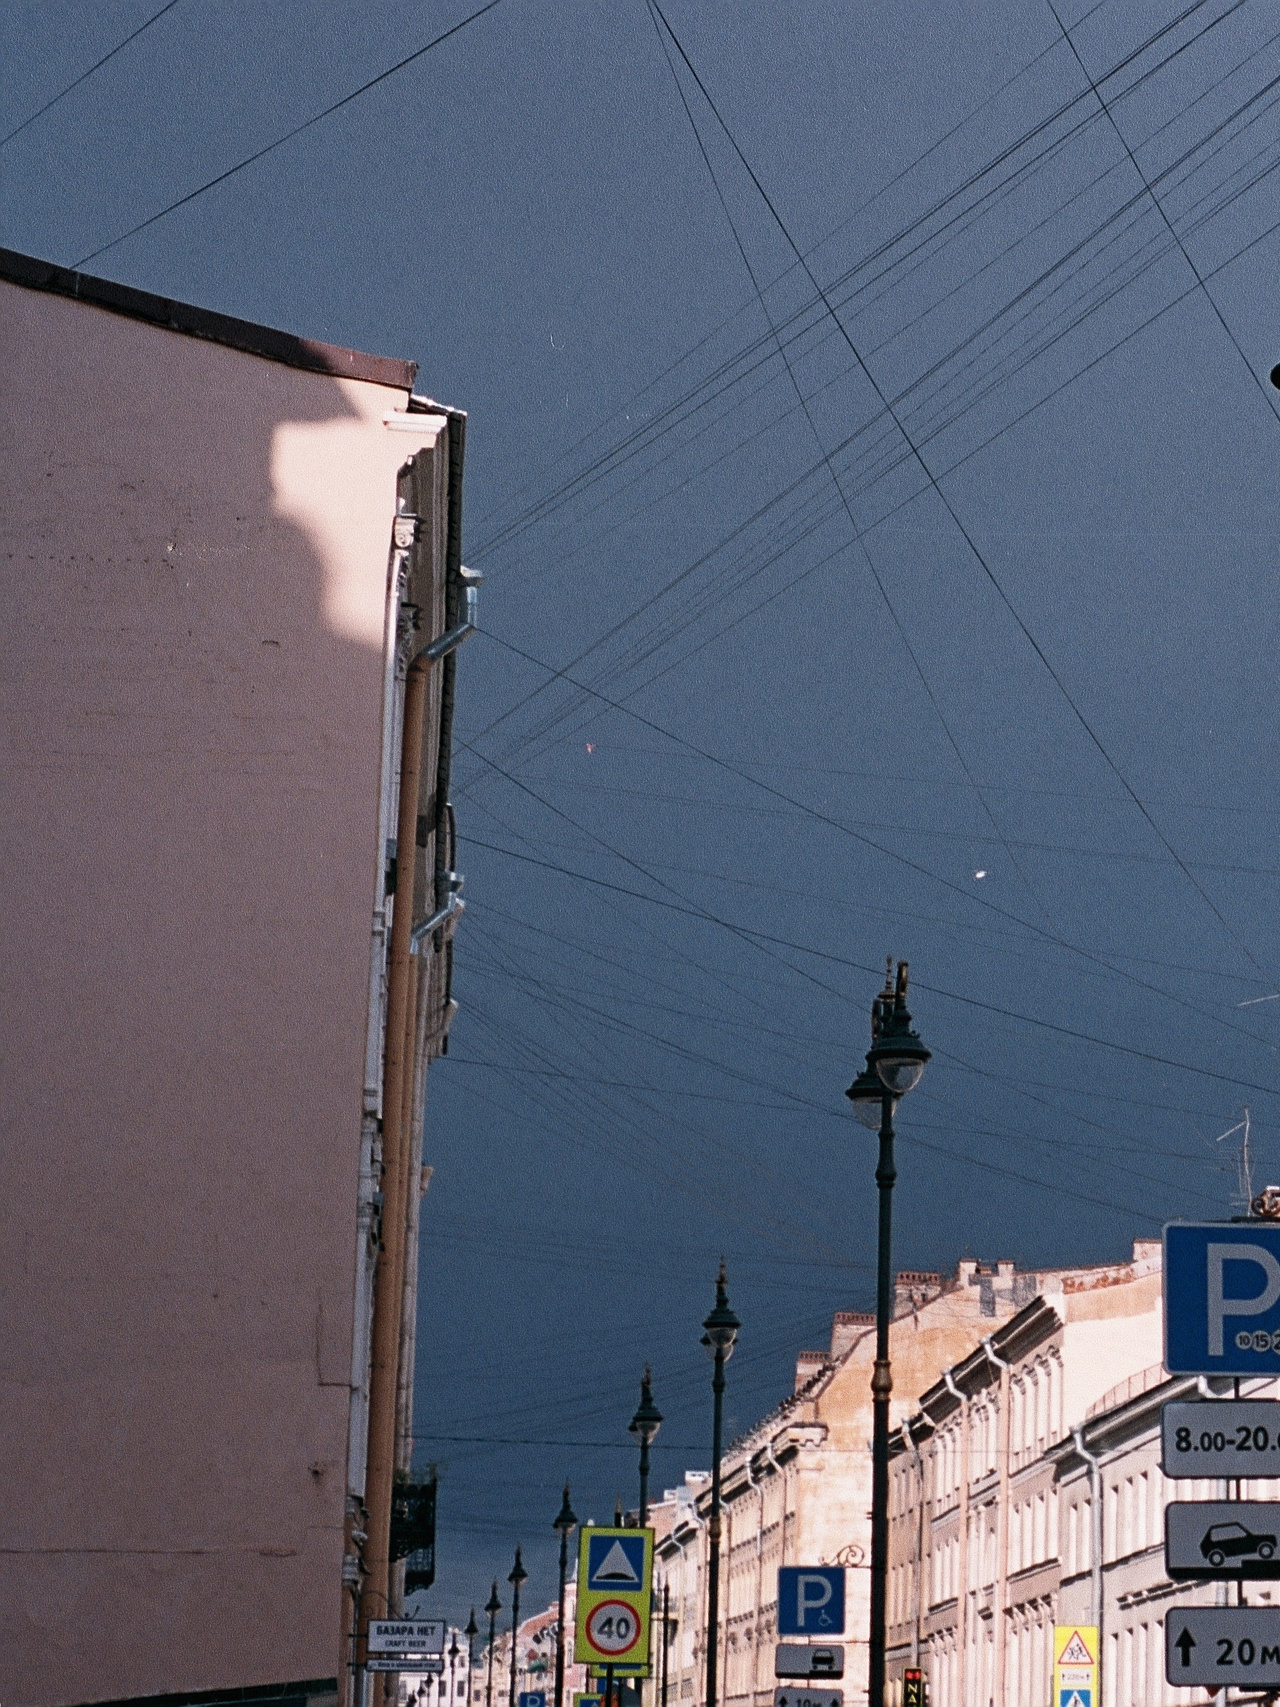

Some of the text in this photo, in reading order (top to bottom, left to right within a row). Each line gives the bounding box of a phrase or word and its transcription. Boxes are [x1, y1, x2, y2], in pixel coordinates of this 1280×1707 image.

[1239, 1335, 1249, 1345] 10
[1255, 1334, 1269, 1348] 15
[797, 1574, 833, 1627] P
[376, 1625, 436, 1636] БАЗАРА НЕТ
[597, 1616, 630, 1640] 40
